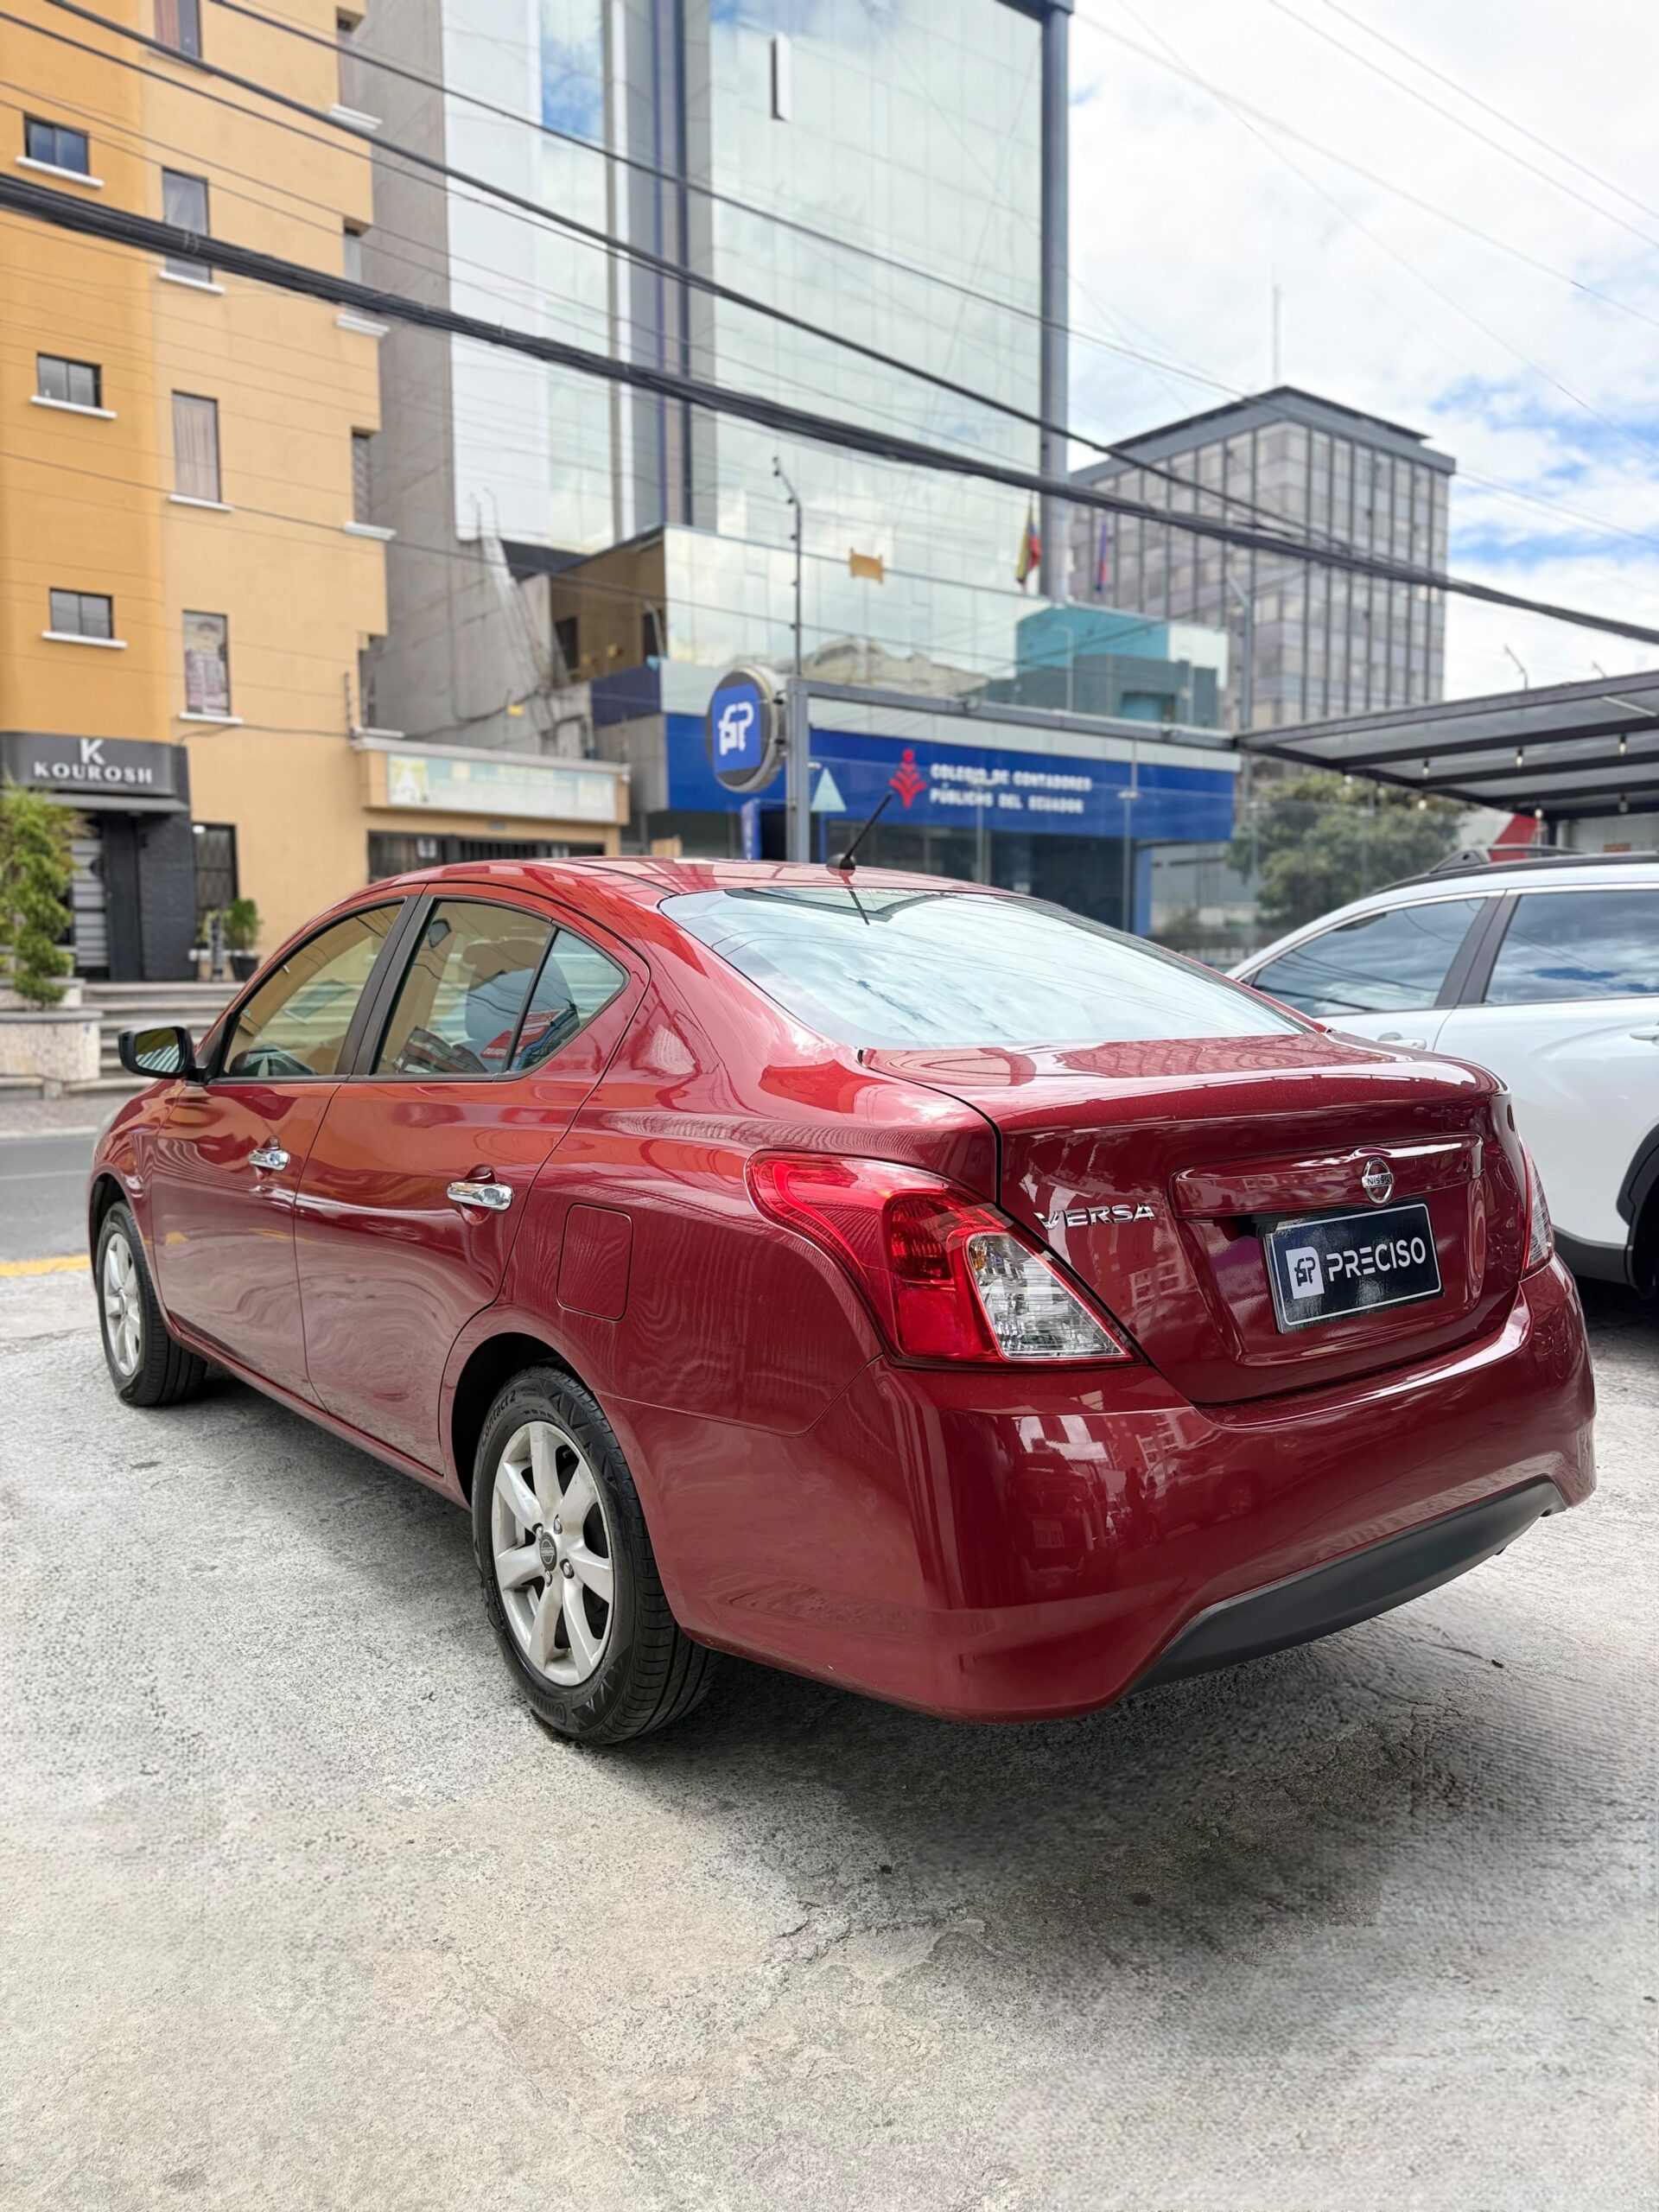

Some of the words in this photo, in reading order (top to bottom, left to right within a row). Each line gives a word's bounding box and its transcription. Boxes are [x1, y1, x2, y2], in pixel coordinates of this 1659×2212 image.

[79, 737, 105, 766] K
[34, 760, 153, 784] KOUROSH
[992, 768, 1009, 785] DE
[1013, 770, 1092, 792] CONTADORES
[998, 791, 1023, 810] DEL
[1027, 794, 1084, 815] ECUADOR
[1033, 1202, 1156, 1230] VERSA
[1325, 1236, 1426, 1282] PRECISO
